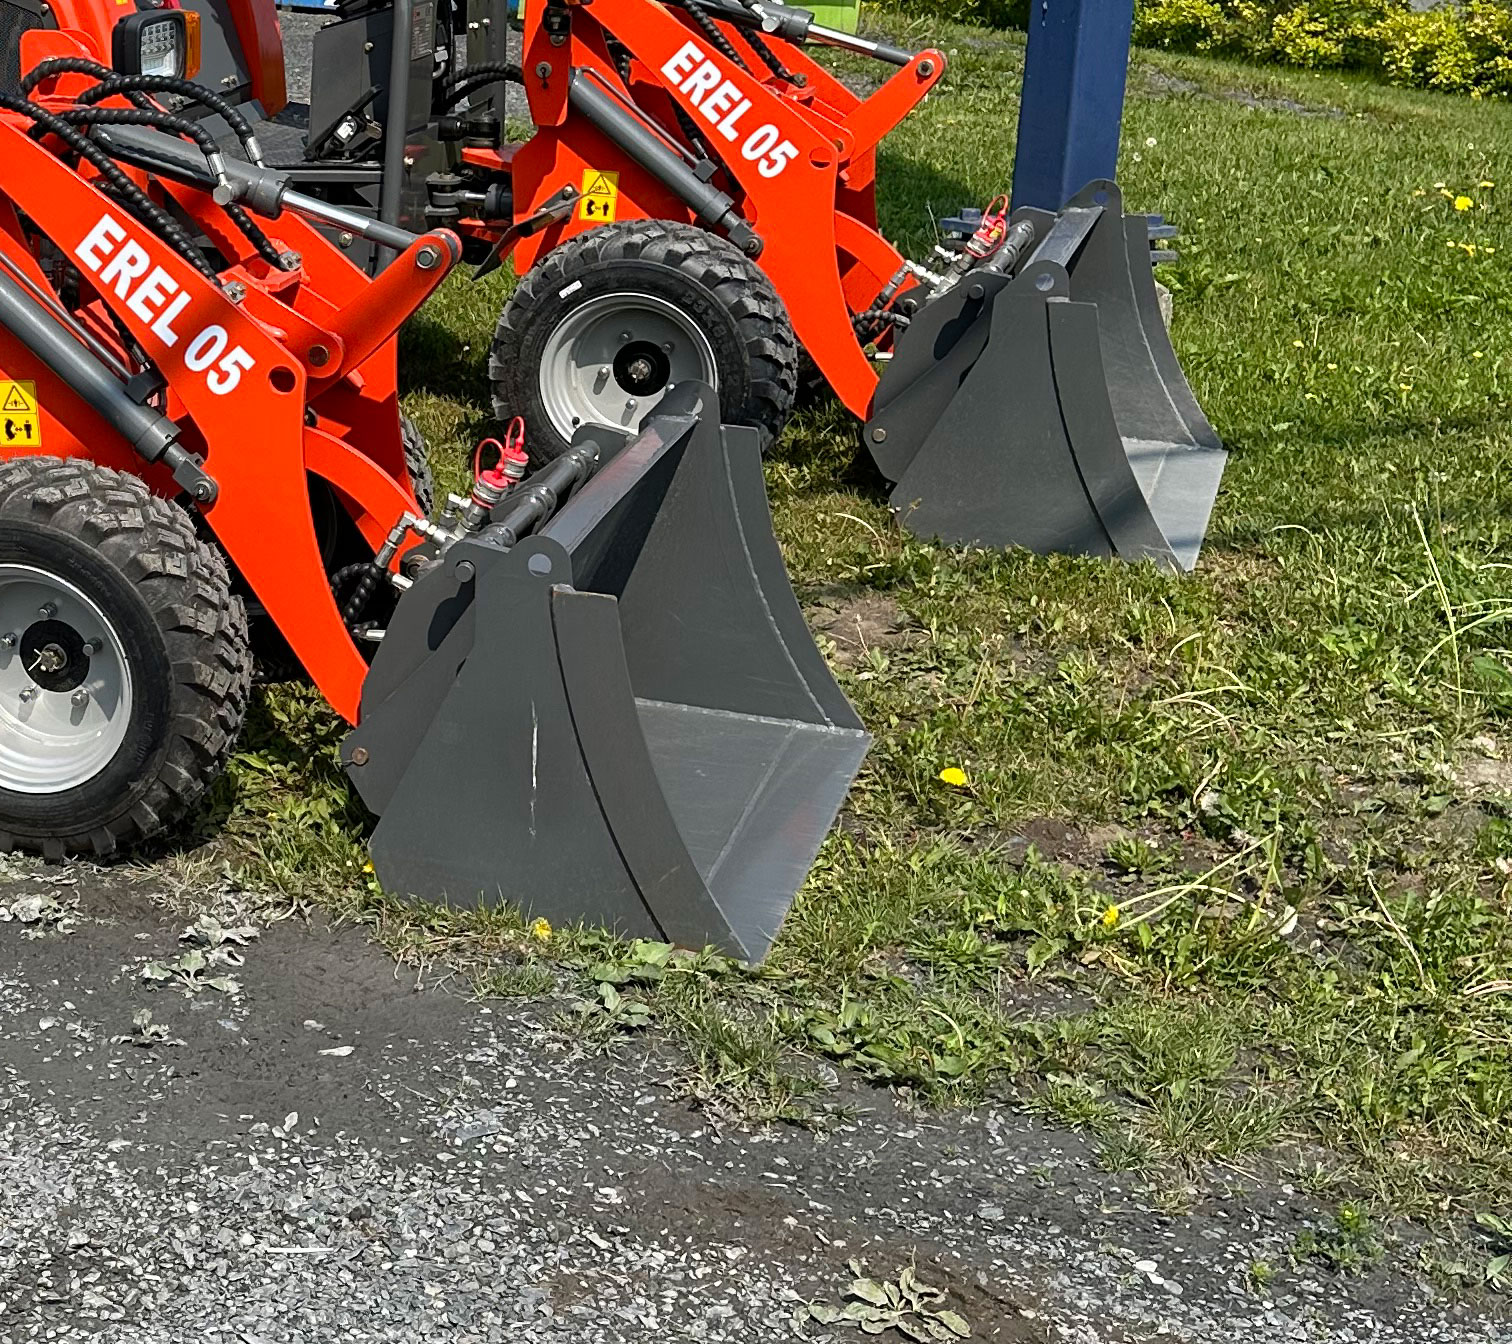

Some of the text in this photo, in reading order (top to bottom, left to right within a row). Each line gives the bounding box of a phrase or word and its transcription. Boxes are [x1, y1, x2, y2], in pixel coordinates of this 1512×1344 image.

[660, 40, 800, 178] EREL 05
[74, 213, 256, 395] EREL 05
